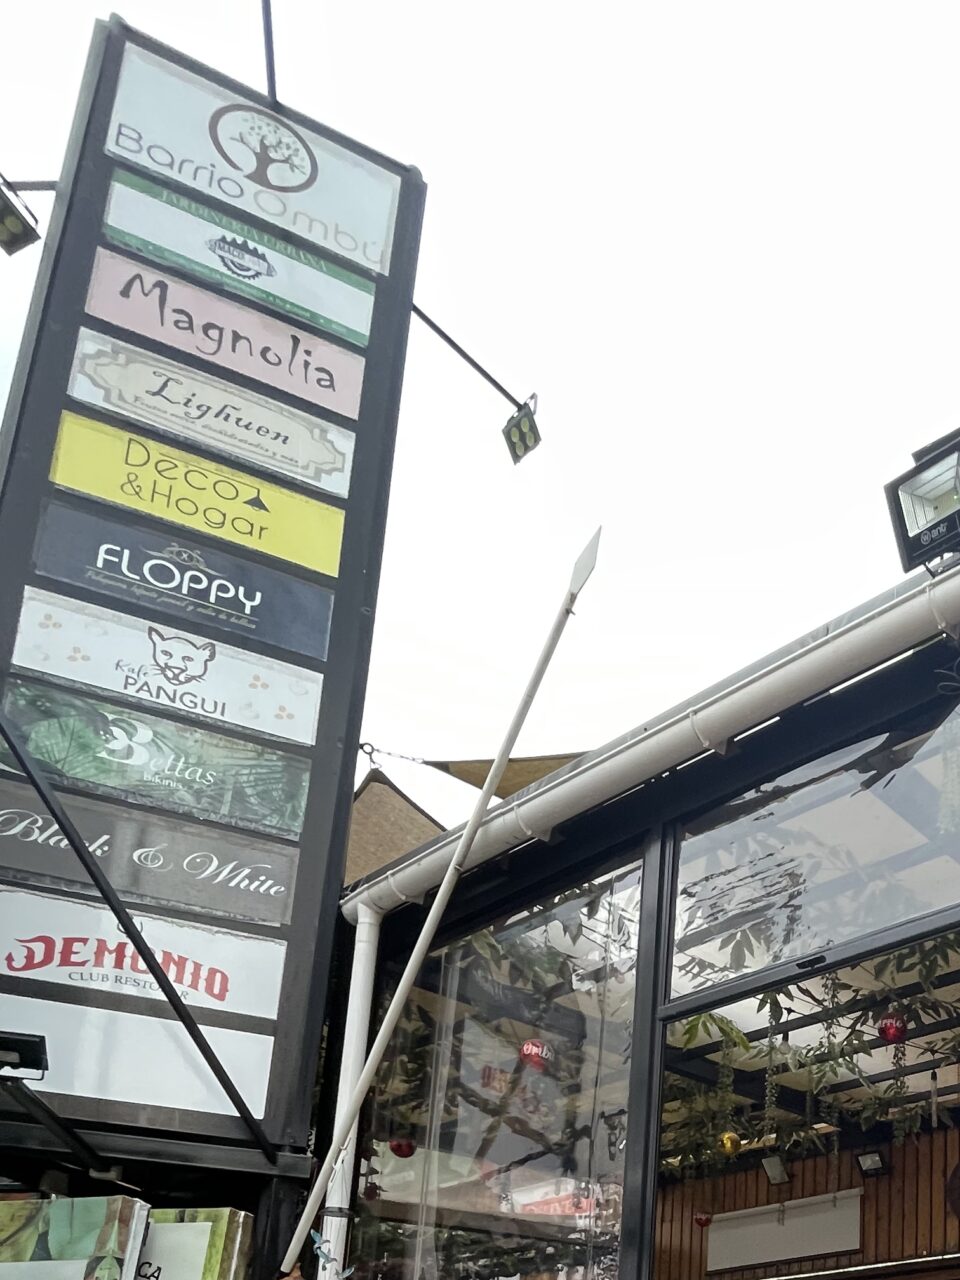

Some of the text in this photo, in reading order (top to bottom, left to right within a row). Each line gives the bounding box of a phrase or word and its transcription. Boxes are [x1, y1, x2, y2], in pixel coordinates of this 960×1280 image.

[115, 123, 245, 199] Barrio
[119, 273, 336, 392] Magnolia
[145, 370, 291, 445] Lighuen
[125, 437, 239, 501] Deco
[120, 472, 269, 540] &Hogar
[96, 543, 262, 615] FLOPPY
[123, 674, 226, 717] PANGUI
[132, 843, 174, 872] &
[183, 851, 288, 897] White
[4, 935, 230, 1002] DEMONIO
[68, 971, 189, 1000] CLUB RESTOR
